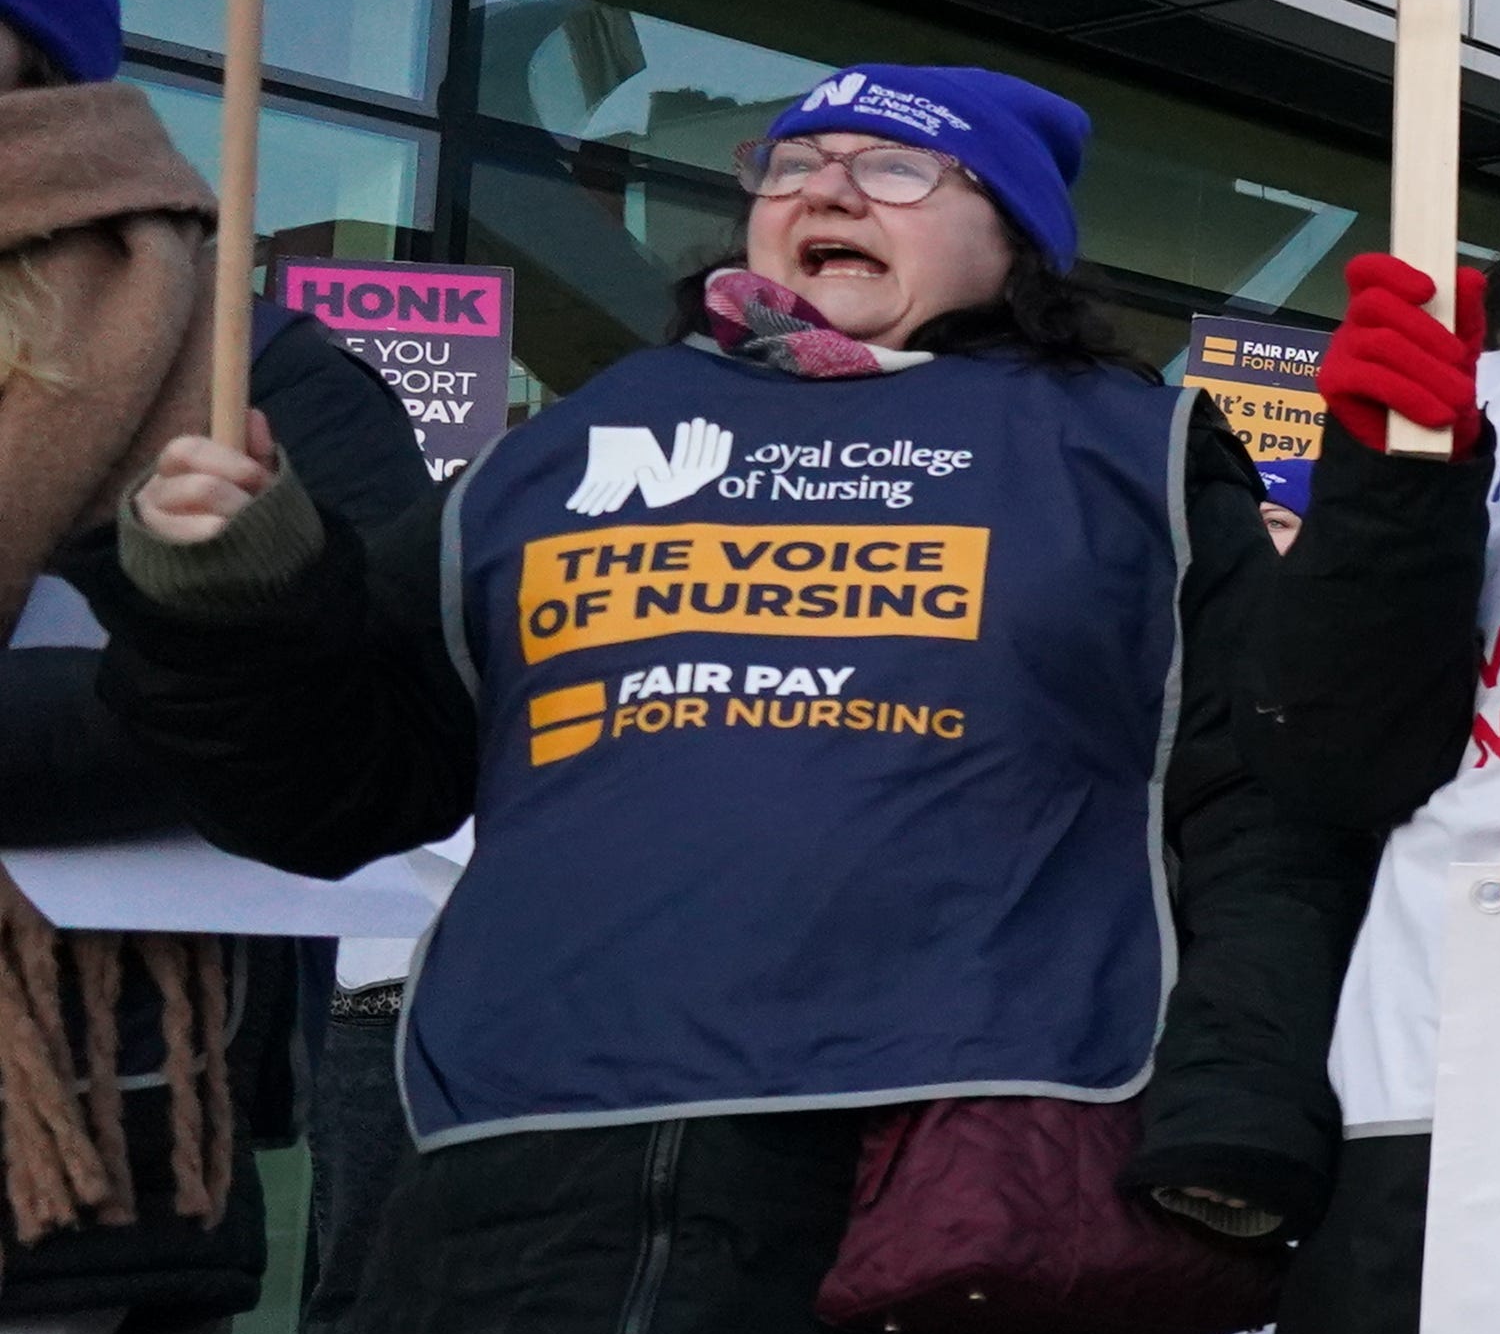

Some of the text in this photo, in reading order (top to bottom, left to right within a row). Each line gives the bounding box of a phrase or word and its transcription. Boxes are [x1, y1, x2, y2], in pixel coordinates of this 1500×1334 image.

[302, 280, 488, 325] HONK
[375, 338, 450, 366] YOU
[1241, 355, 1275, 372] FOR
[1242, 341, 1320, 364] FAIR PAY
[1263, 399, 1328, 428] time
[745, 440, 974, 481] oyal College
[1259, 431, 1312, 457] pay
[718, 470, 915, 509] of Nursing
[557, 539, 946, 583] THE VOICE
[529, 582, 970, 639] OF NURSING
[618, 663, 857, 705] FAIR PAY
[612, 698, 966, 740] FOR NURSING
